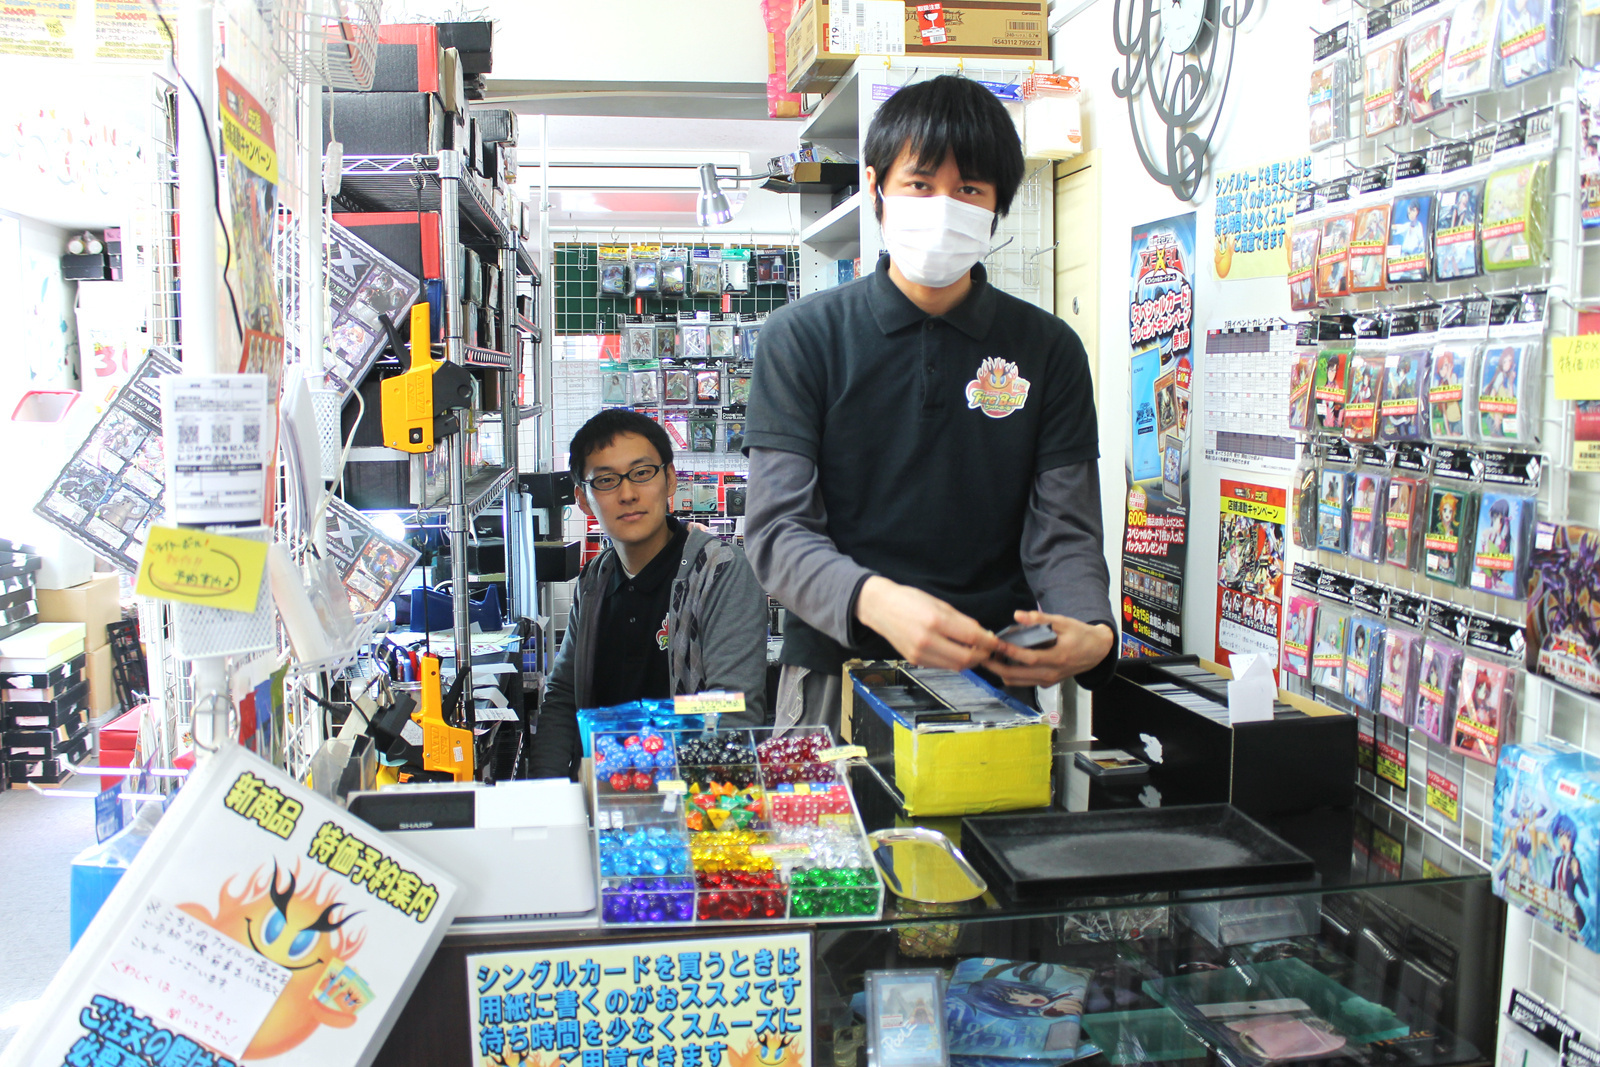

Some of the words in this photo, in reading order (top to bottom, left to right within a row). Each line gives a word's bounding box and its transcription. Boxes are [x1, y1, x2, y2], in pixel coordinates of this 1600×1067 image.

[1216, 156, 1312, 197] シングルカードを買うときは
[1234, 228, 1286, 253] ご用意できます
[972, 390, 998, 408] Fire
[998, 393, 1027, 407] Ball
[399, 821, 433, 830] SHARP
[223, 770, 304, 840] 新商品
[306, 820, 440, 923] 特価予約案内
[476, 947, 801, 994] シングルカードを買うときは
[477, 976, 802, 1025] 用紙に書くのがおススメです
[1515, 992, 1544, 1020] CHARACTER
[479, 1006, 802, 1056] 待ち時間を少なくスムーズに
